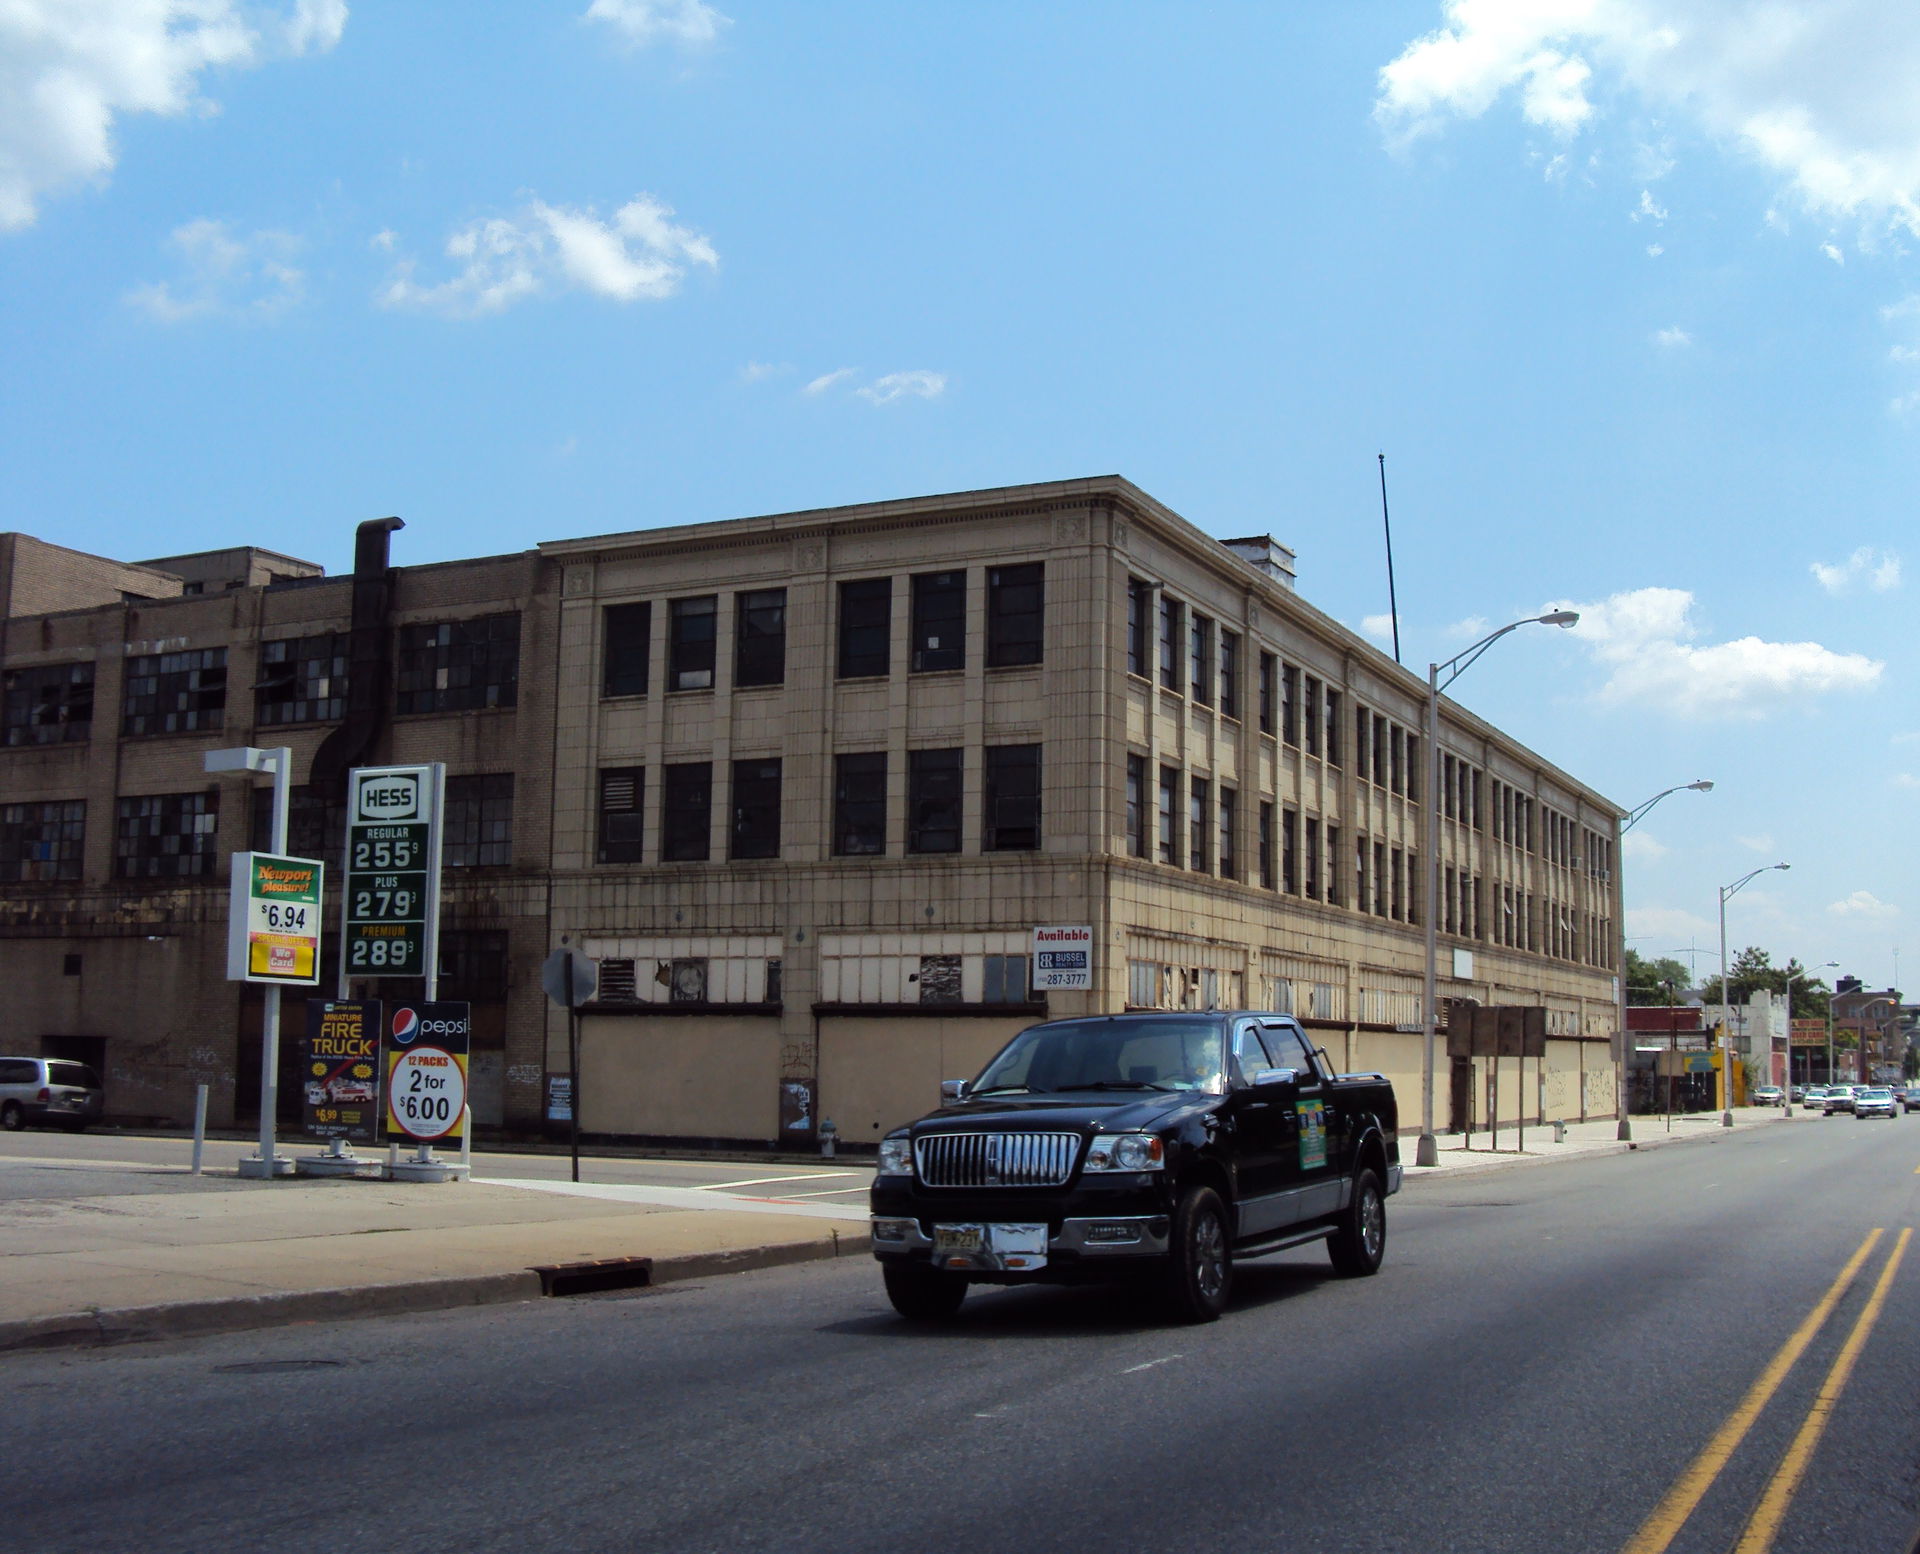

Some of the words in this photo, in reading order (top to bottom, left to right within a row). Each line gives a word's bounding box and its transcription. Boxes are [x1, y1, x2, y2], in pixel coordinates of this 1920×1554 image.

[366, 787, 412, 807] HESS
[367, 827, 409, 839] REGULAR
[258, 866, 313, 882] Newport
[261, 881, 310, 894] pleasure!
[375, 876, 398, 888] PLUS
[261, 904, 305, 929] $6.94
[362, 925, 406, 937] PREMIUM
[1037, 929, 1089, 941] Available
[275, 948, 291, 958] We
[1055, 952, 1085, 961] BUSSEL
[270, 957, 294, 968] Card
[1047, 973, 1087, 985] 287-3777
[320, 1022, 363, 1038] FIRE
[420, 1018, 467, 1037] pepsi
[311, 1038, 373, 1055] TRUCK
[407, 1055, 416, 1066] 12
[418, 1056, 449, 1067] PACKS
[410, 1069, 422, 1092] 2
[424, 1074, 446, 1089] for
[400, 1096, 449, 1121] $6.00
